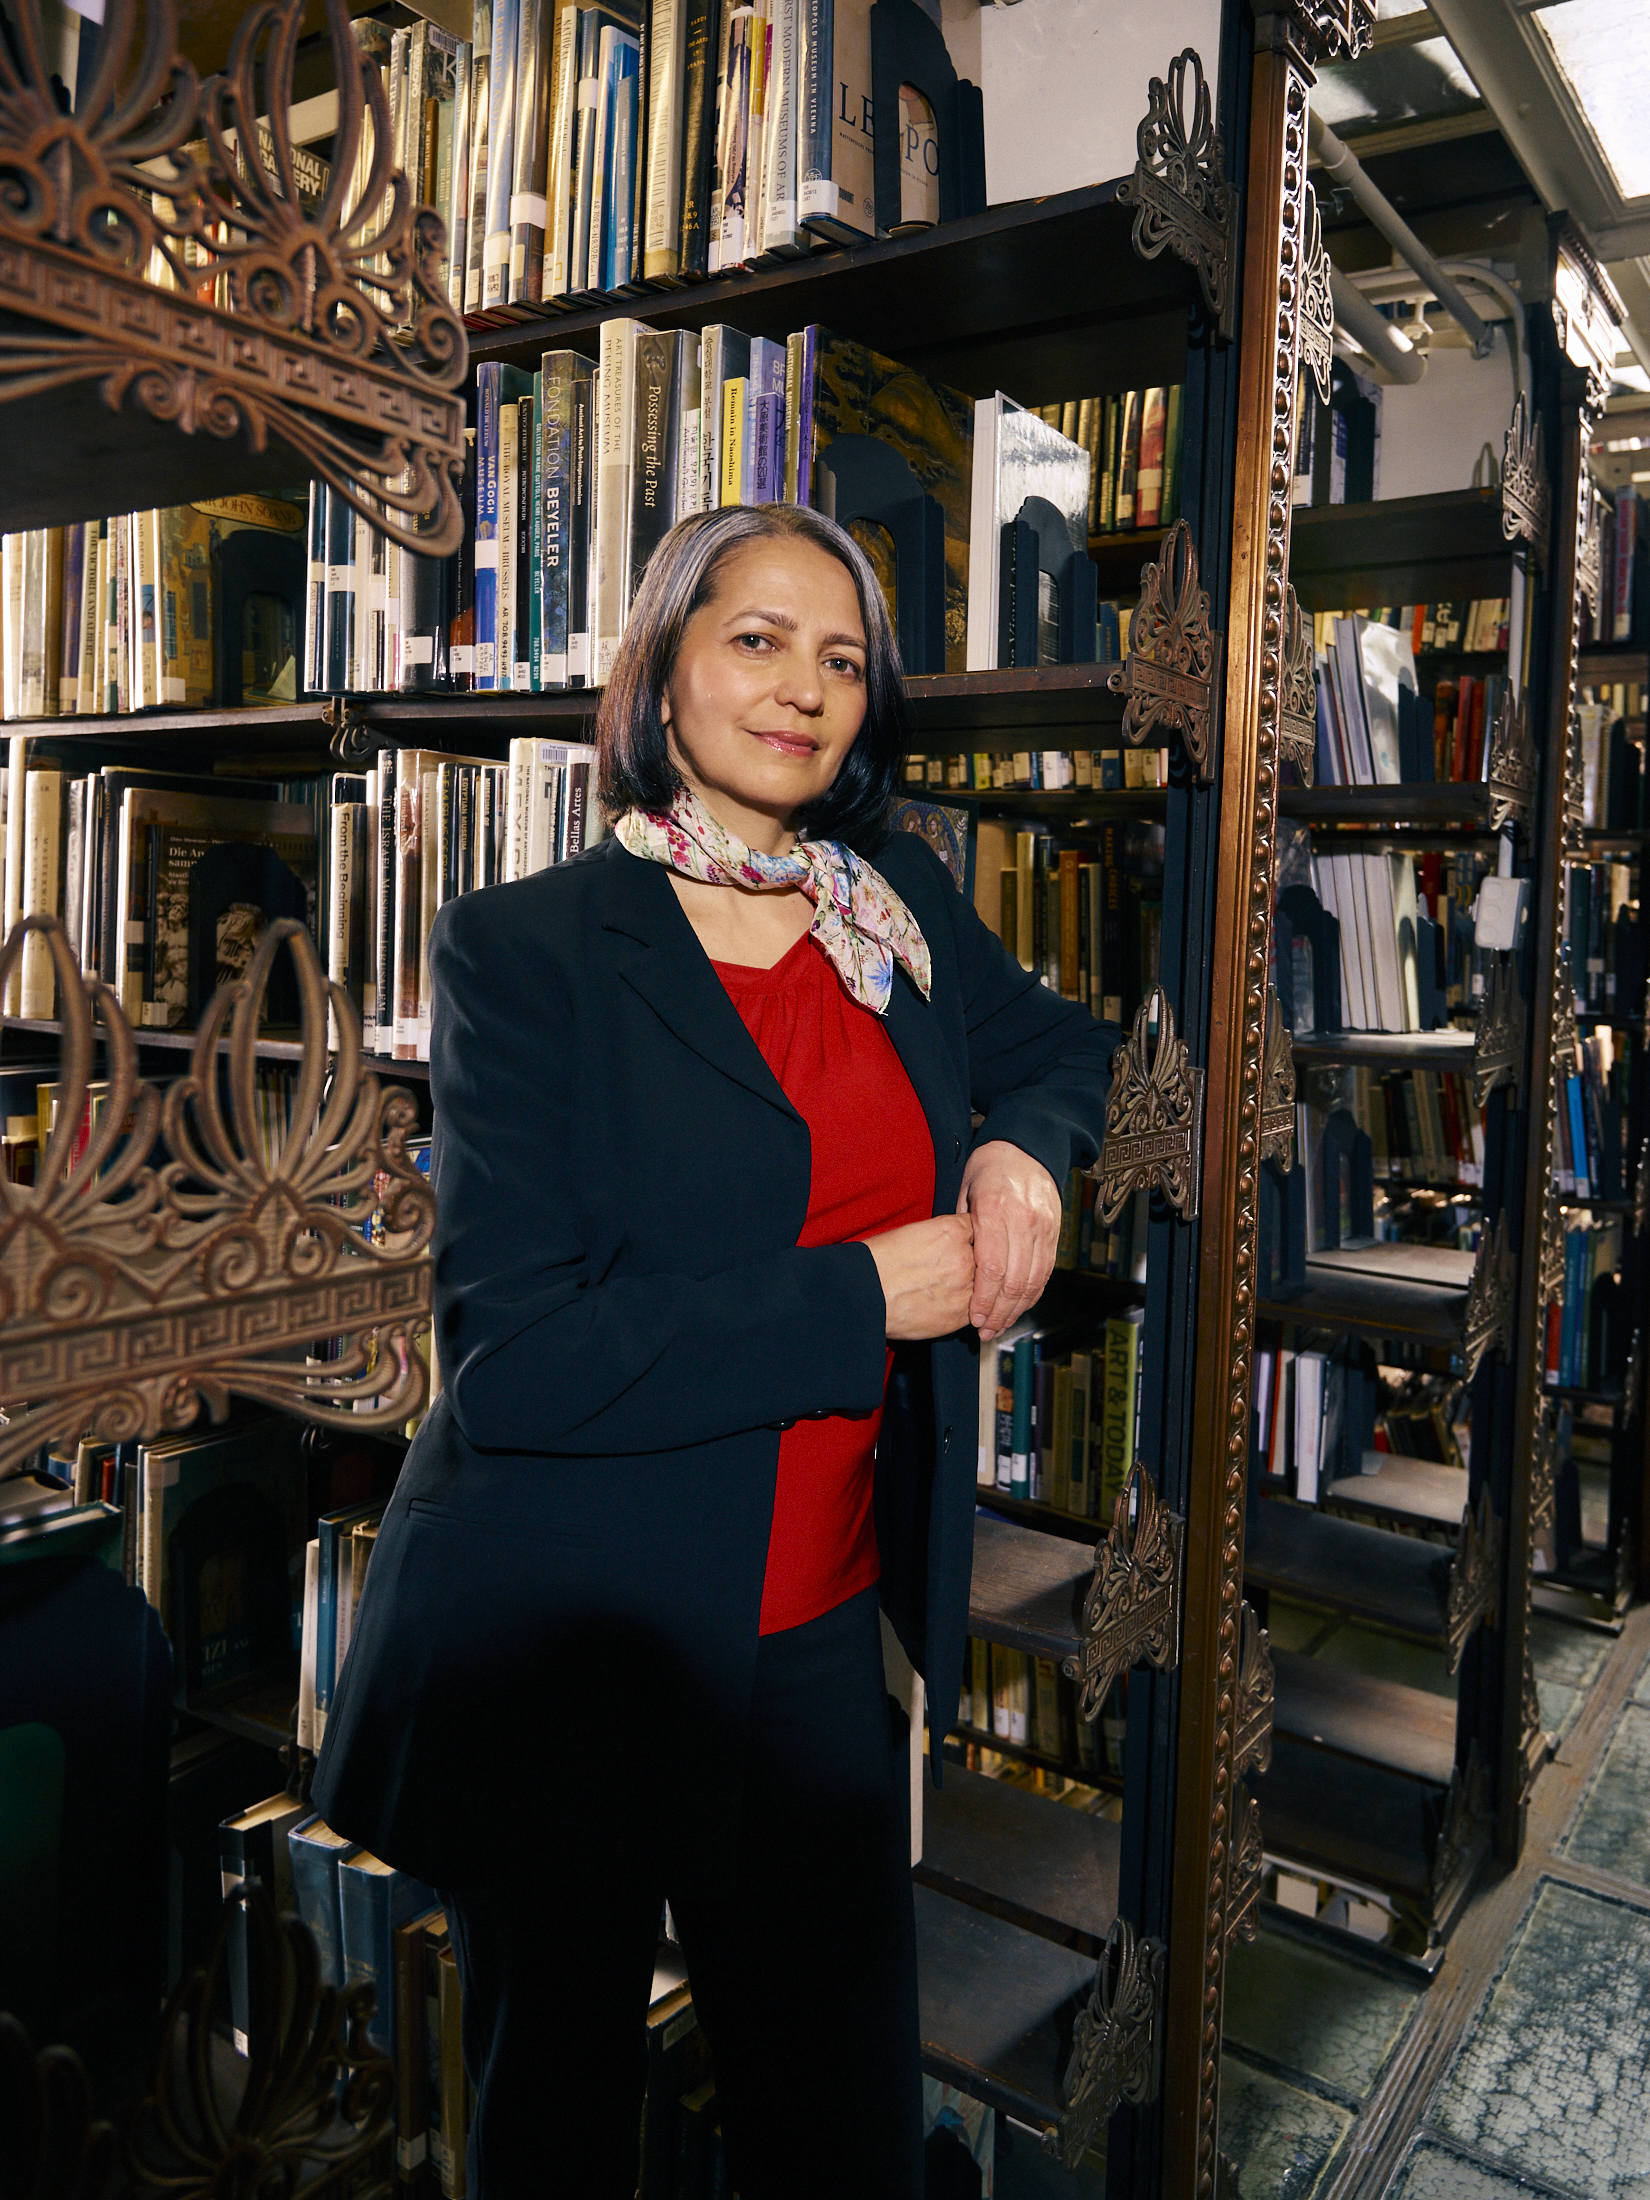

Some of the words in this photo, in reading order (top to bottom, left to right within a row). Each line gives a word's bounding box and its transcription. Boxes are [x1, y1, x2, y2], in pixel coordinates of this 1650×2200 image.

[639, 23, 646, 32] BY
[784, 0, 794, 22] RST
[811, 0, 819, 37] EOPOLD
[494, 16, 504, 84] KREMLIN
[561, 19, 572, 60] NATURAL
[652, 18, 672, 88] TREASURES
[783, 26, 792, 86] MODERN
[391, 46, 400, 77] THE
[411, 44, 423, 99] KUSKOVO
[457, 58, 466, 80] THE
[551, 44, 562, 98] MOSCOW
[810, 40, 818, 80] MUSEUM
[810, 83, 818, 95] IN
[549, 105, 558, 158] KREMLIN
[778, 91, 790, 158] MUSEUMS
[424, 134, 432, 169] HERMITAGE
[620, 156, 628, 176] MUSEUM
[777, 161, 787, 180] OF
[776, 183, 786, 202] AR
[604, 339, 612, 388] PEKING
[615, 338, 623, 357] ART
[614, 360, 622, 413] TREASURES
[786, 347, 794, 390] NATIONAL
[484, 415, 490, 424] DE
[603, 394, 612, 455] MUSEUM
[614, 416, 622, 430] OF
[641, 385, 662, 453] Possessing
[729, 388, 738, 425] Remain
[785, 391, 794, 432] MUSEUM
[546, 376, 561, 480] FONDATION
[578, 438, 584, 446] to
[613, 434, 621, 452] THE
[729, 427, 737, 437] in
[487, 455, 496, 478] VAN
[503, 440, 511, 462] THE
[645, 456, 662, 477] the
[728, 439, 736, 486] Naoshima
[477, 456, 486, 516] MUSEUM
[502, 465, 511, 499] ROYAL
[576, 446, 585, 506] Post-Impressionism
[644, 478, 658, 508] Past
[220, 497, 253, 515] JOHN
[256, 503, 297, 525] SOANE
[487, 480, 497, 514] GOGH
[90, 530, 98, 550] THE
[501, 501, 510, 544] MUSEUM
[533, 516, 541, 541] LAUGIER,
[546, 487, 560, 568] BEYELER
[88, 550, 97, 596] VICTORIA
[501, 552, 510, 600] BRUSSELS
[87, 599, 96, 619] AND
[502, 607, 509, 618] AR
[85, 621, 94, 658] ALBERT
[382, 795, 393, 822] THE
[400, 792, 409, 832] Hundred
[442, 789, 450, 836] MUSEUMS
[461, 777, 470, 815] EGYPTIAN
[484, 777, 492, 816] MUSEUMS
[572, 787, 582, 818] Artes
[339, 812, 350, 848] From
[484, 817, 490, 827] OF
[524, 832, 529, 840] OF
[570, 820, 582, 854] Bellas
[169, 847, 188, 858] Die
[338, 849, 350, 870] the
[381, 827, 392, 870] ISRAEL
[442, 837, 449, 852] OF
[42, 837, 50, 916] MASTERWOR
[336, 873, 349, 940] Beginning
[378, 939, 390, 1012] JERUSALEM
[1108, 1328, 1129, 1384] ART
[1107, 1387, 1128, 1406] &
[1105, 1411, 1126, 1494] TODAY
